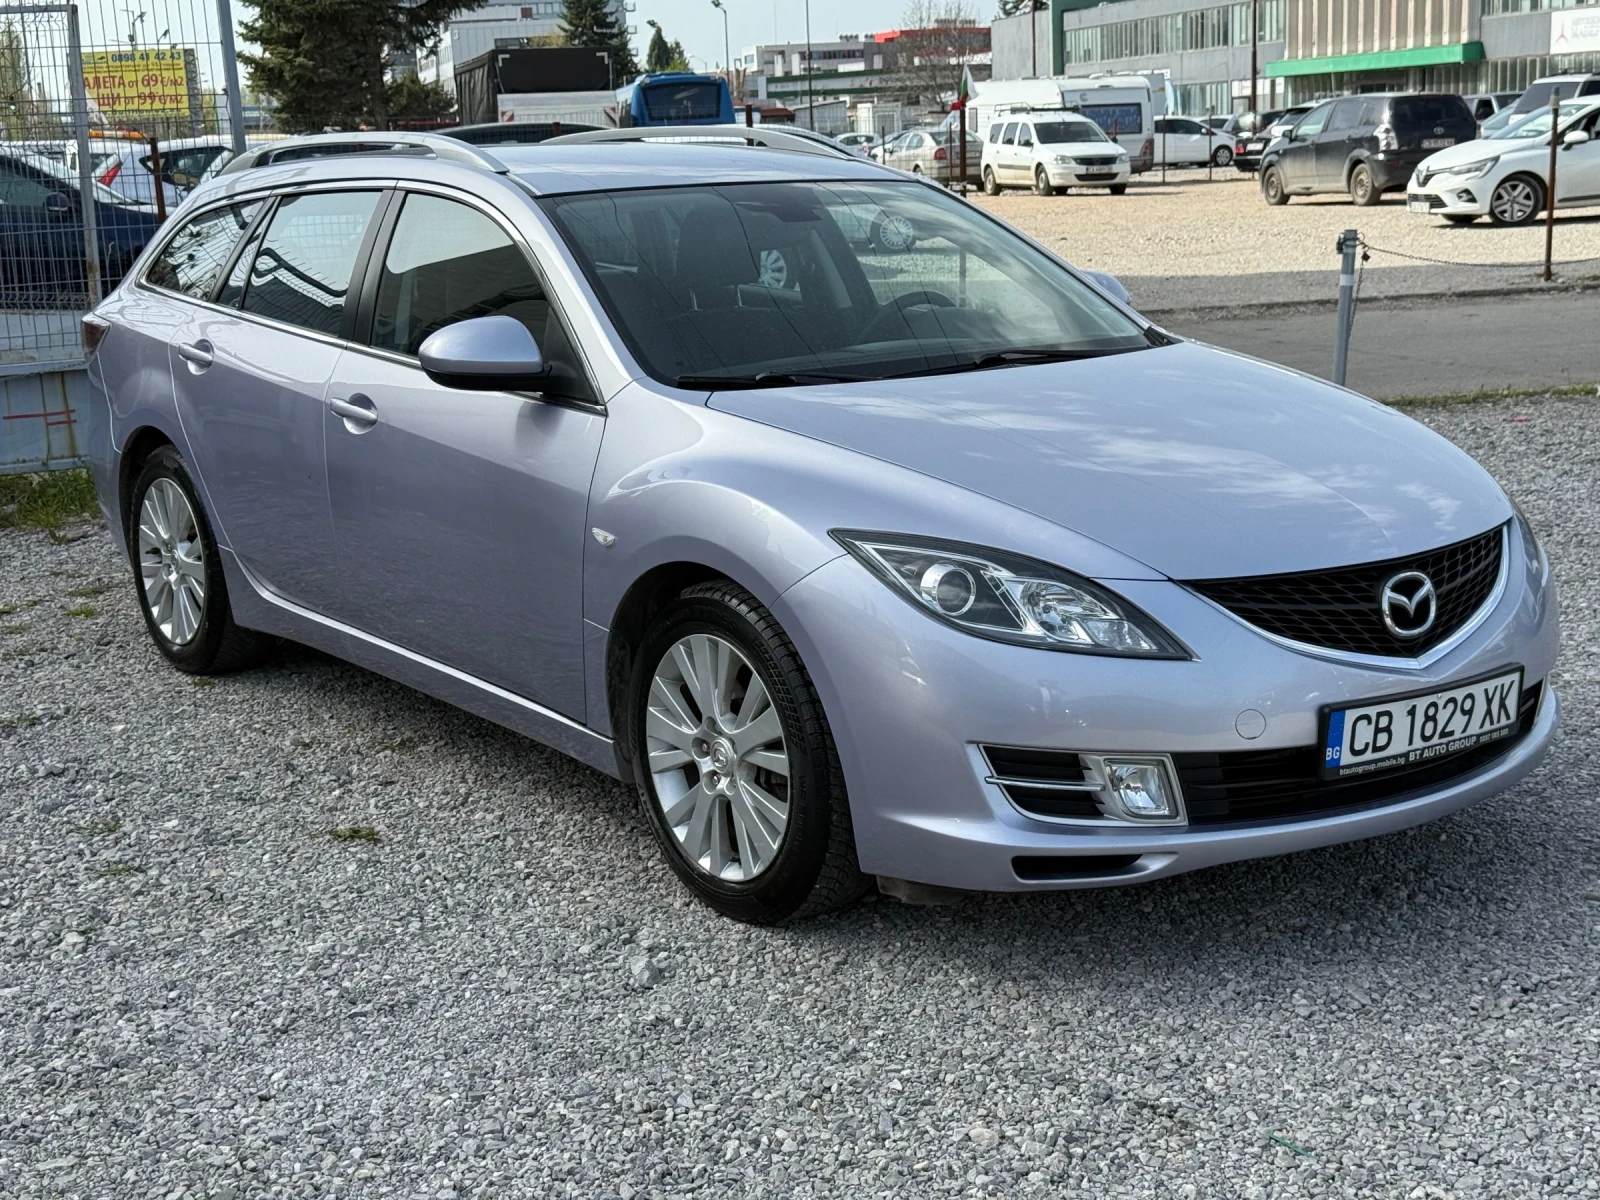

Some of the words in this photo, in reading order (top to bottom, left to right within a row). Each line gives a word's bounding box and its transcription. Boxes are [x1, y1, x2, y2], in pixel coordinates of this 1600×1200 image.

[1349, 710, 1394, 757] CB
[1406, 692, 1476, 747] 1829
[1479, 680, 1515, 730] XK
[1325, 746, 1341, 761] BG
[1339, 756, 1405, 776] btautogroup.mobile.bg
[1408, 751, 1422, 761] BT
[1422, 744, 1447, 759] AUTO
[1448, 736, 1477, 752] GROUP
